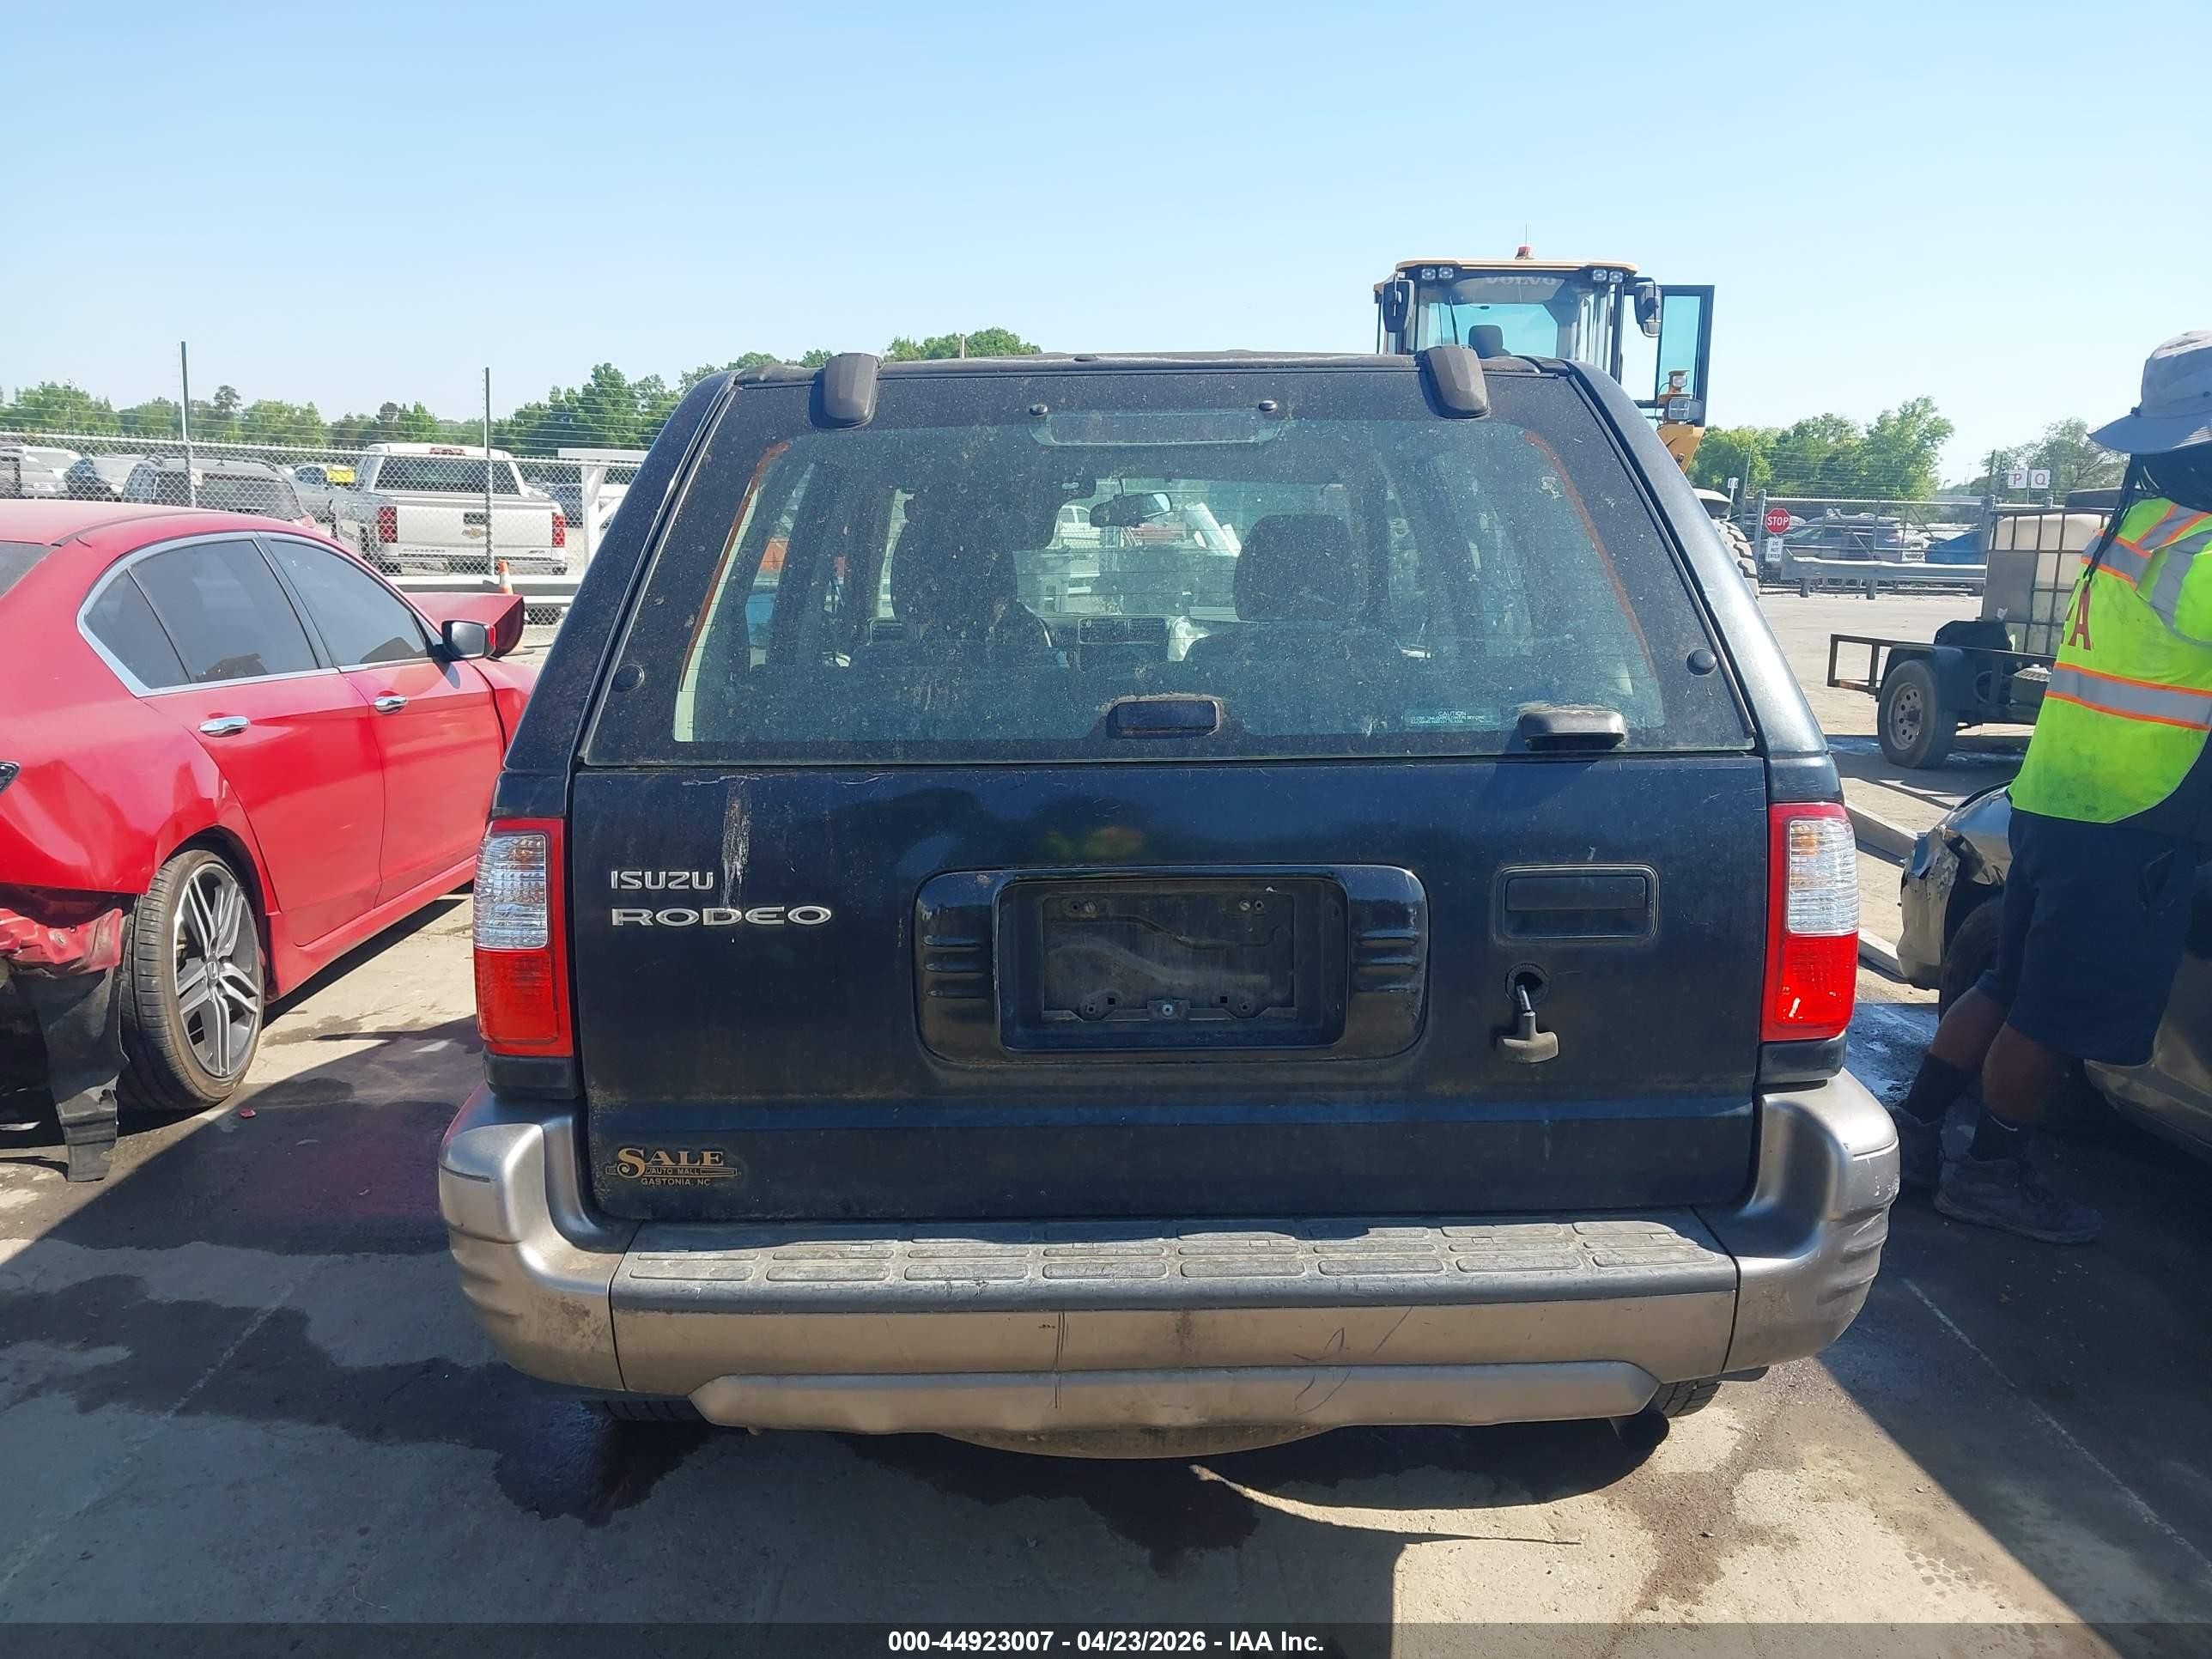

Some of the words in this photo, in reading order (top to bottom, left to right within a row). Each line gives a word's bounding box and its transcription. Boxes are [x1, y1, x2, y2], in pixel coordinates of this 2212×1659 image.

[1484, 276, 1557, 285] VOLVO
[2035, 473, 2046, 485] Q
[1767, 516, 1789, 526] STOP
[611, 871, 714, 890] ISUZU
[611, 906, 832, 926] RODEO
[617, 1148, 724, 1179] SALE
